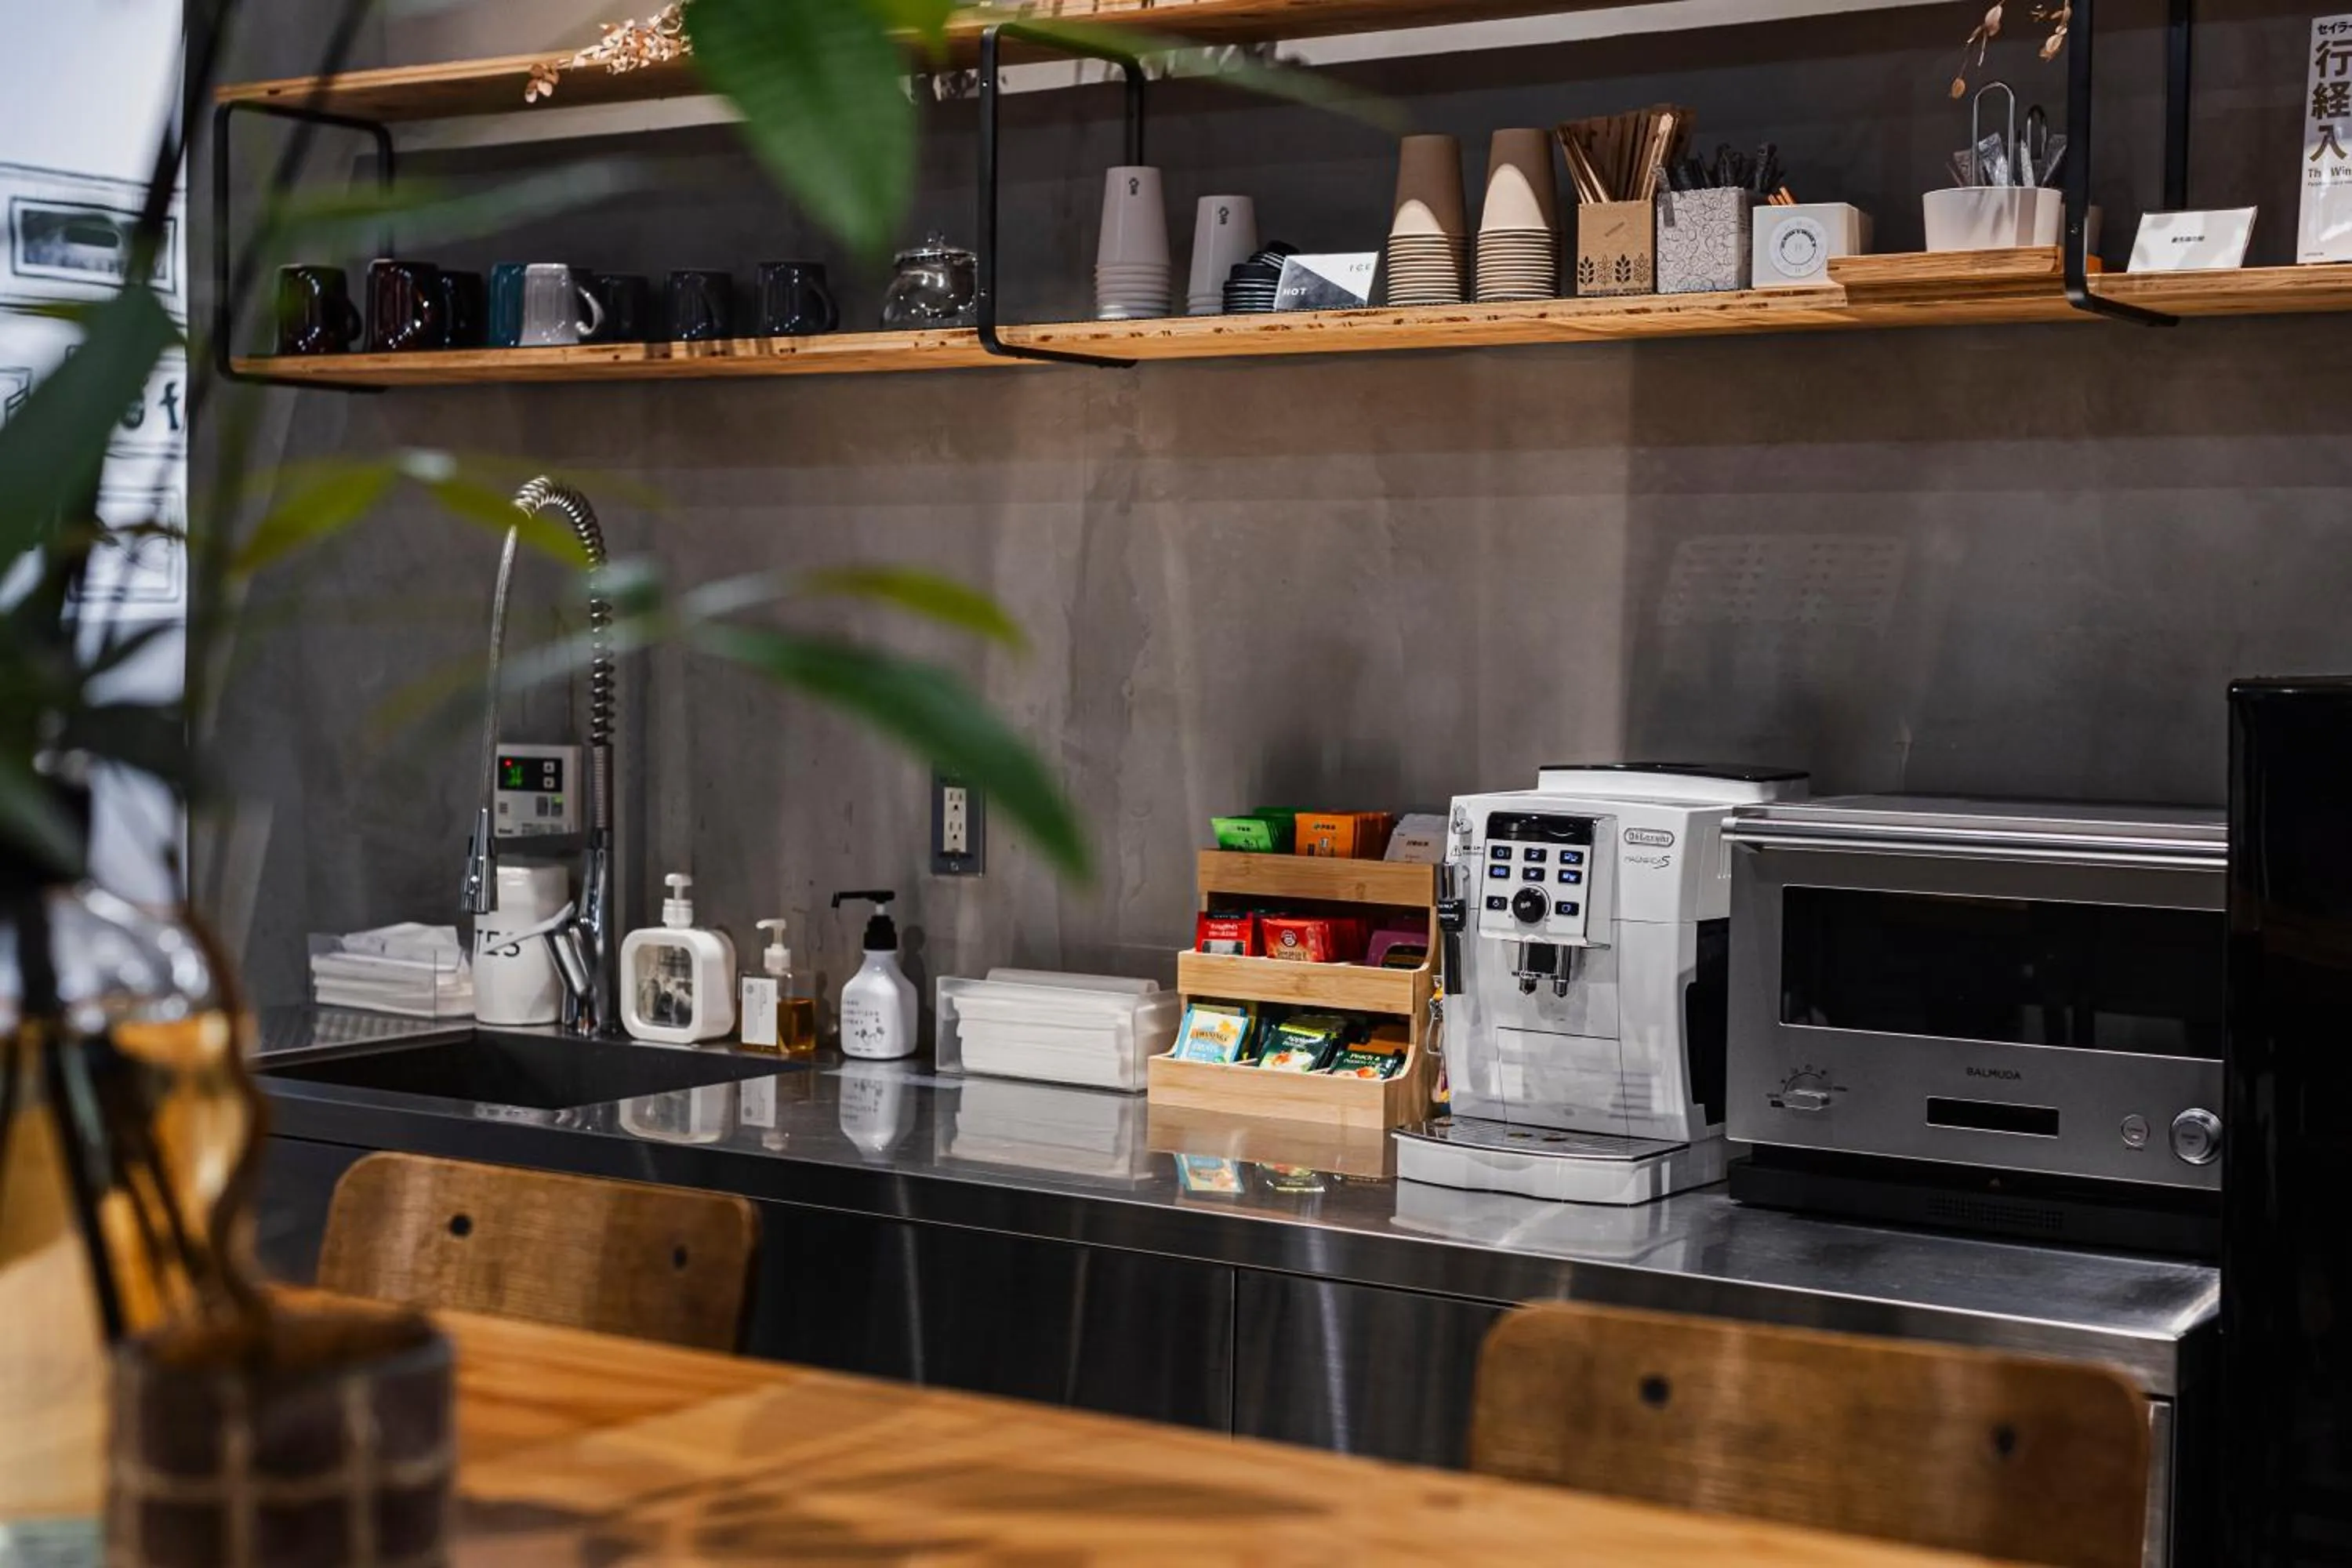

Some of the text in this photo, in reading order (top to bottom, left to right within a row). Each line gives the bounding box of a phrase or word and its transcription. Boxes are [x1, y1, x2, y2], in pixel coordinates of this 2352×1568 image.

[1349, 263, 1372, 272] ICE
[1283, 287, 1308, 296] HOT
[1966, 1067, 2022, 1080] BALMUDA
